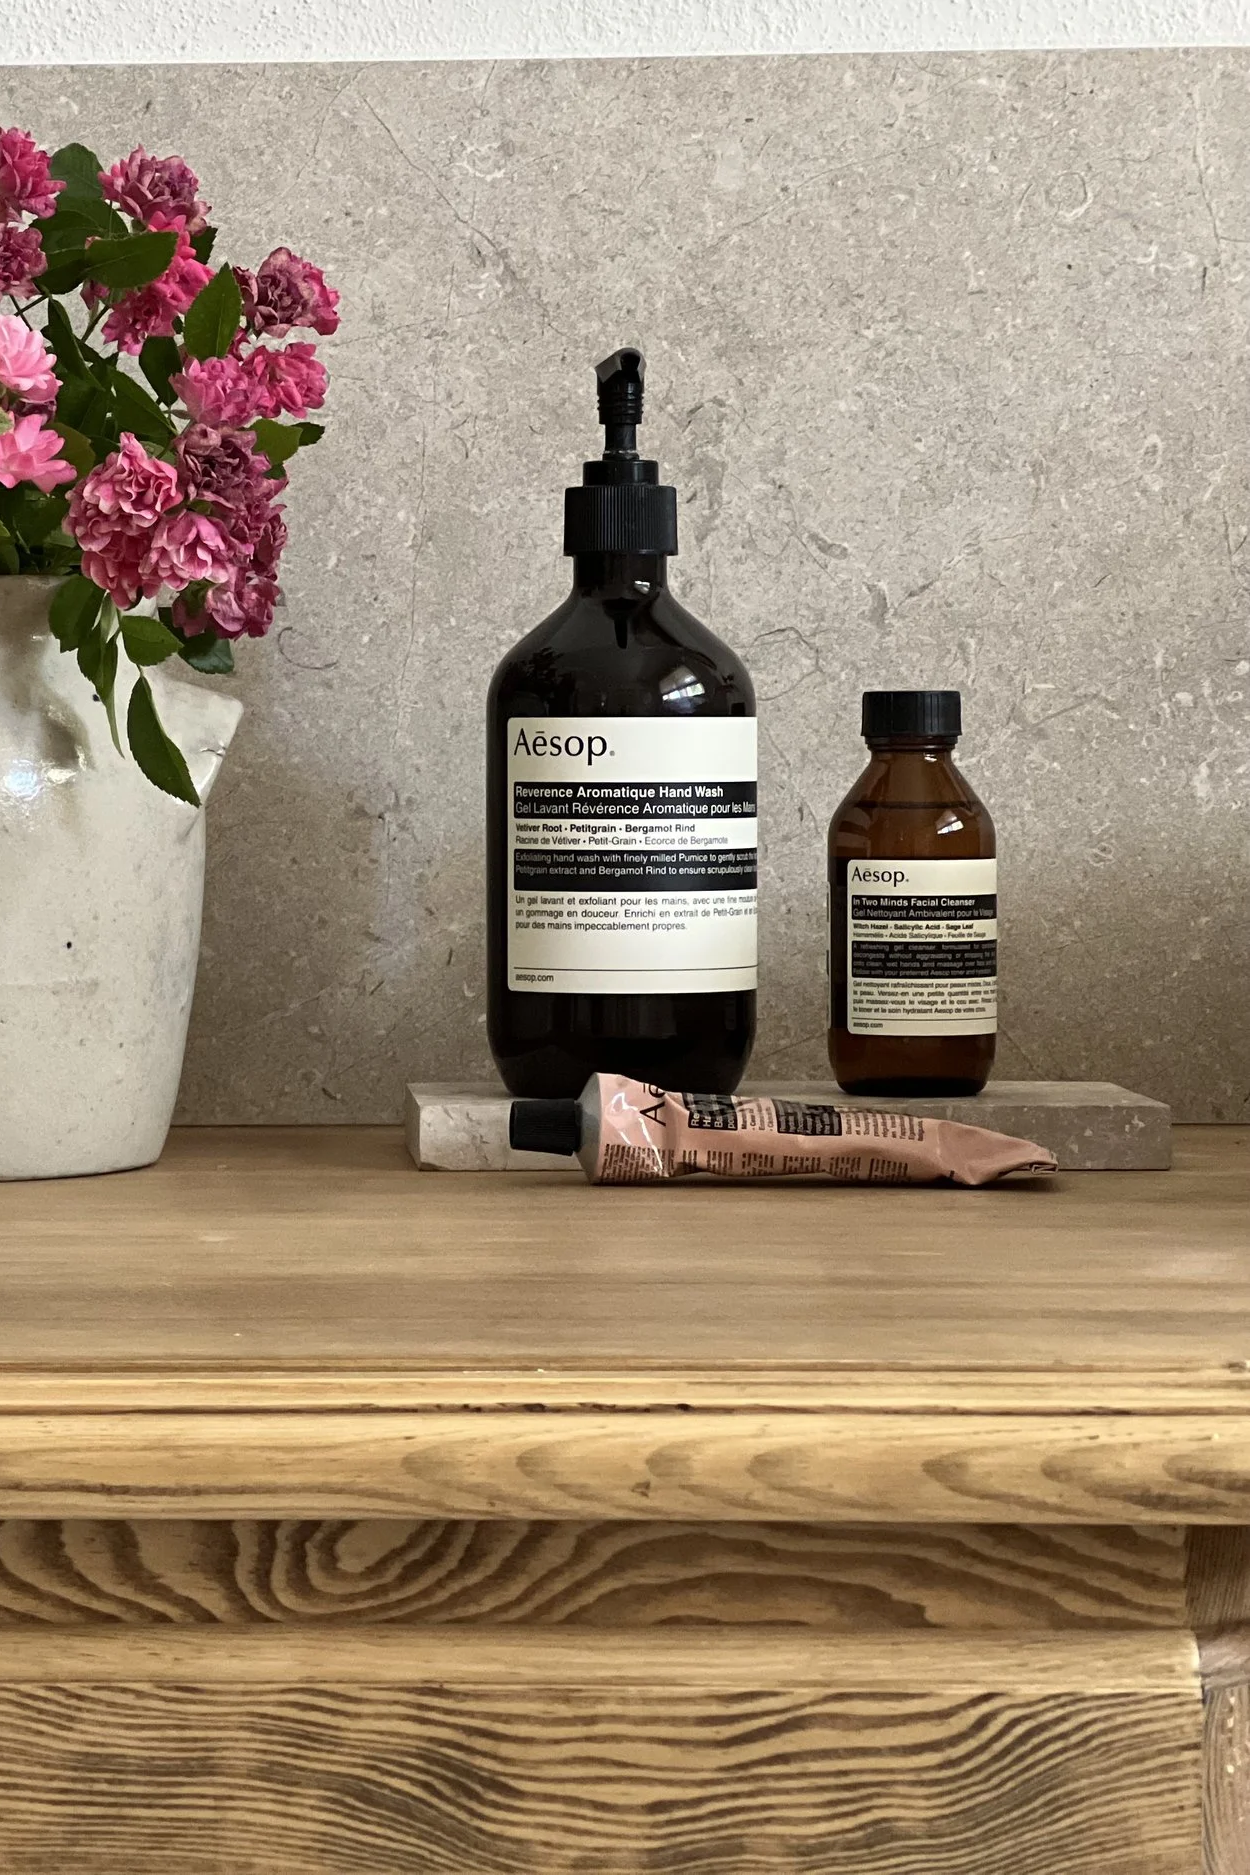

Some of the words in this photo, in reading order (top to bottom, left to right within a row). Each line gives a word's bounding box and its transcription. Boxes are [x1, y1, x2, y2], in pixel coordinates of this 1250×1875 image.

[515, 786, 573, 798] Reverence
[577, 786, 656, 801] Aromatique
[659, 786, 692, 798] Hand
[694, 786, 724, 798] Wash
[515, 802, 531, 814] Gel
[533, 802, 569, 814] Lavant
[572, 802, 640, 814] Révérence
[642, 802, 708, 816] Aromatique
[710, 804, 731, 816] pour
[731, 802, 742, 813] les
[515, 823, 540, 832] Vetiver
[542, 823, 563, 833] Root
[570, 823, 616, 835] Petitgrain
[625, 824, 673, 835] Bergamot
[675, 824, 695, 832] Rind
[515, 836, 539, 845] Racine
[540, 836, 550, 845] de
[551, 836, 581, 845] Vétiver
[588, 836, 637, 845] Petit-Grain
[678, 836, 688, 845] de
[690, 836, 729, 847] Bergamote
[515, 852, 551, 864] Exfoliating
[553, 853, 574, 862] hand
[576, 853, 600, 862] wash
[602, 853, 621, 862] with
[623, 853, 648, 864] finely
[650, 853, 677, 862] milled
[679, 853, 708, 862] Pumice
[709, 854, 717, 862] to
[717, 853, 736, 864] gently
[515, 865, 548, 876] Petitgrain
[549, 866, 577, 875] extract
[579, 866, 596, 875] and
[598, 866, 643, 877] Bergamot
[645, 866, 667, 875] Rind
[668, 866, 677, 875] to
[678, 867, 706, 875] ensure
[707, 865, 743, 875] scrupulously
[515, 895, 525, 904] Un
[527, 896, 538, 906] gel
[540, 896, 564, 905] lavant
[567, 896, 576, 905] et
[578, 896, 617, 906] exfoliant
[620, 898, 641, 907] pour
[645, 897, 658, 905] les
[692, 897, 710, 905] avec
[853, 897, 860, 906] In
[861, 897, 878, 906] Two
[880, 898, 908, 906] Minds
[911, 898, 939, 906] Facial
[940, 898, 976, 906] Cleanser
[525, 909, 564, 919] gommage
[624, 909, 656, 918] Enrichi
[659, 910, 670, 918] en
[673, 909, 699, 918] extrait
[701, 908, 711, 917] de
[853, 908, 865, 917] Gel
[866, 909, 907, 919] Nettoyant
[908, 909, 955, 917] Ambivalent
[956, 910, 973, 918] pour
[515, 921, 530, 930] pour
[531, 921, 546, 929] des
[548, 921, 572, 930] mains
[574, 922, 650, 931] impeccablement
